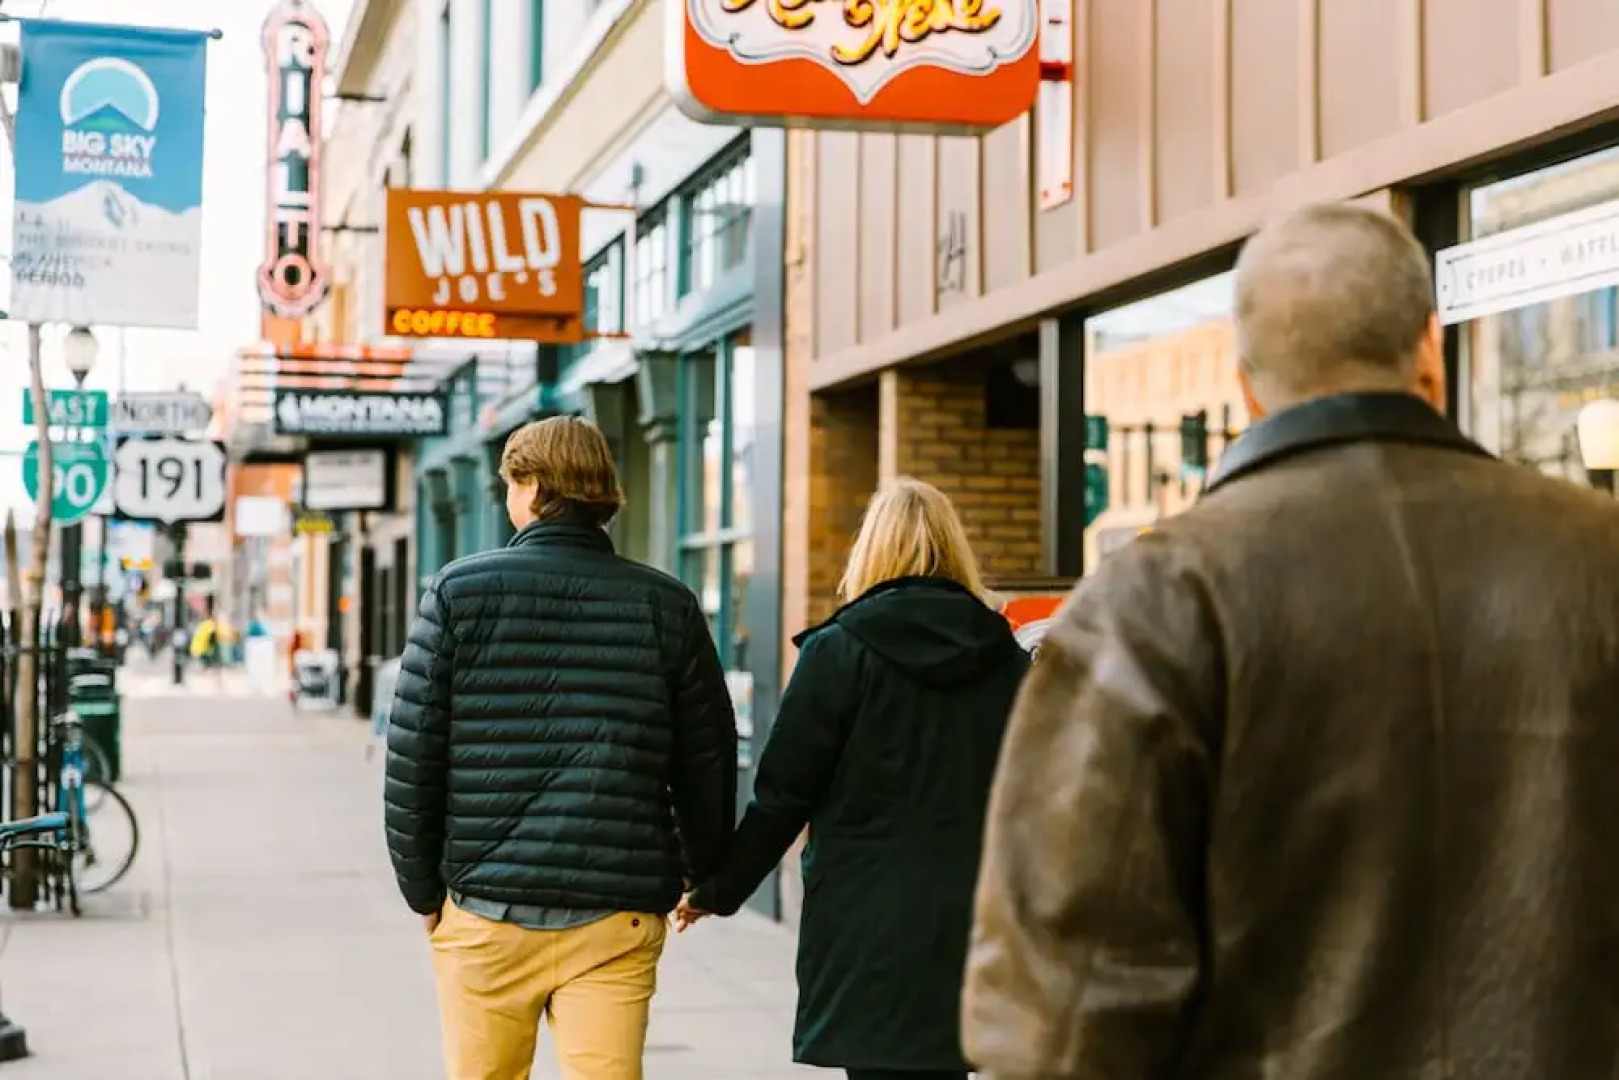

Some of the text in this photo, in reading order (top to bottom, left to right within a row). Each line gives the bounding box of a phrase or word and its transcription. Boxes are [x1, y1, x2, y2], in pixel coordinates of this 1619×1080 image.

[63, 129, 155, 158] BIG SKY
[63, 155, 153, 178] MONTANA
[273, 22, 315, 301] RIALTO
[407, 198, 561, 277] WILD
[432, 268, 557, 305] JOE'S
[392, 308, 495, 337] COFFEE
[51, 397, 98, 424] AST
[121, 399, 200, 424] NORTH
[299, 394, 443, 422] MONTANA
[139, 457, 202, 500] 191
